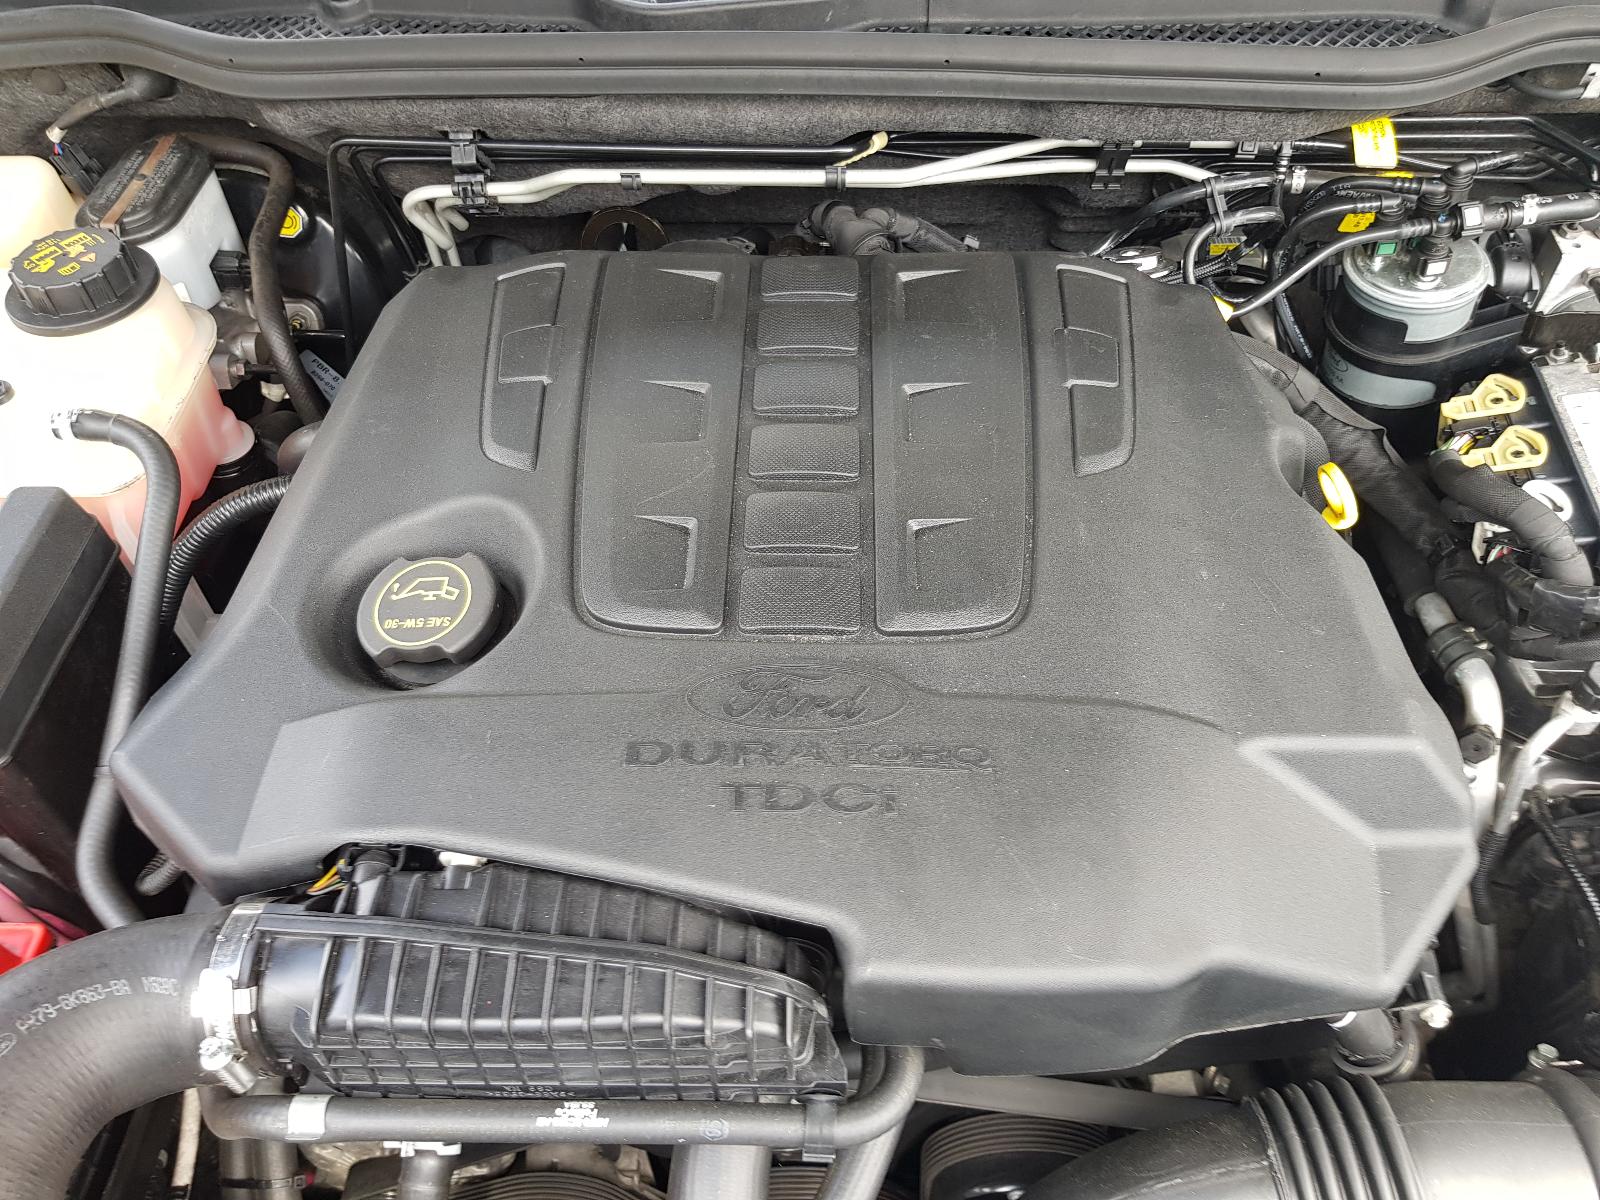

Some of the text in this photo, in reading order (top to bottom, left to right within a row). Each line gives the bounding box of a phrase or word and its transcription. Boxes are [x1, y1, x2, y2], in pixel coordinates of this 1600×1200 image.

[384, 616, 452, 629] SAE 5W-30
[720, 670, 875, 721] Ford
[624, 739, 994, 772] DURATORQ
[720, 781, 900, 815] TDCi
